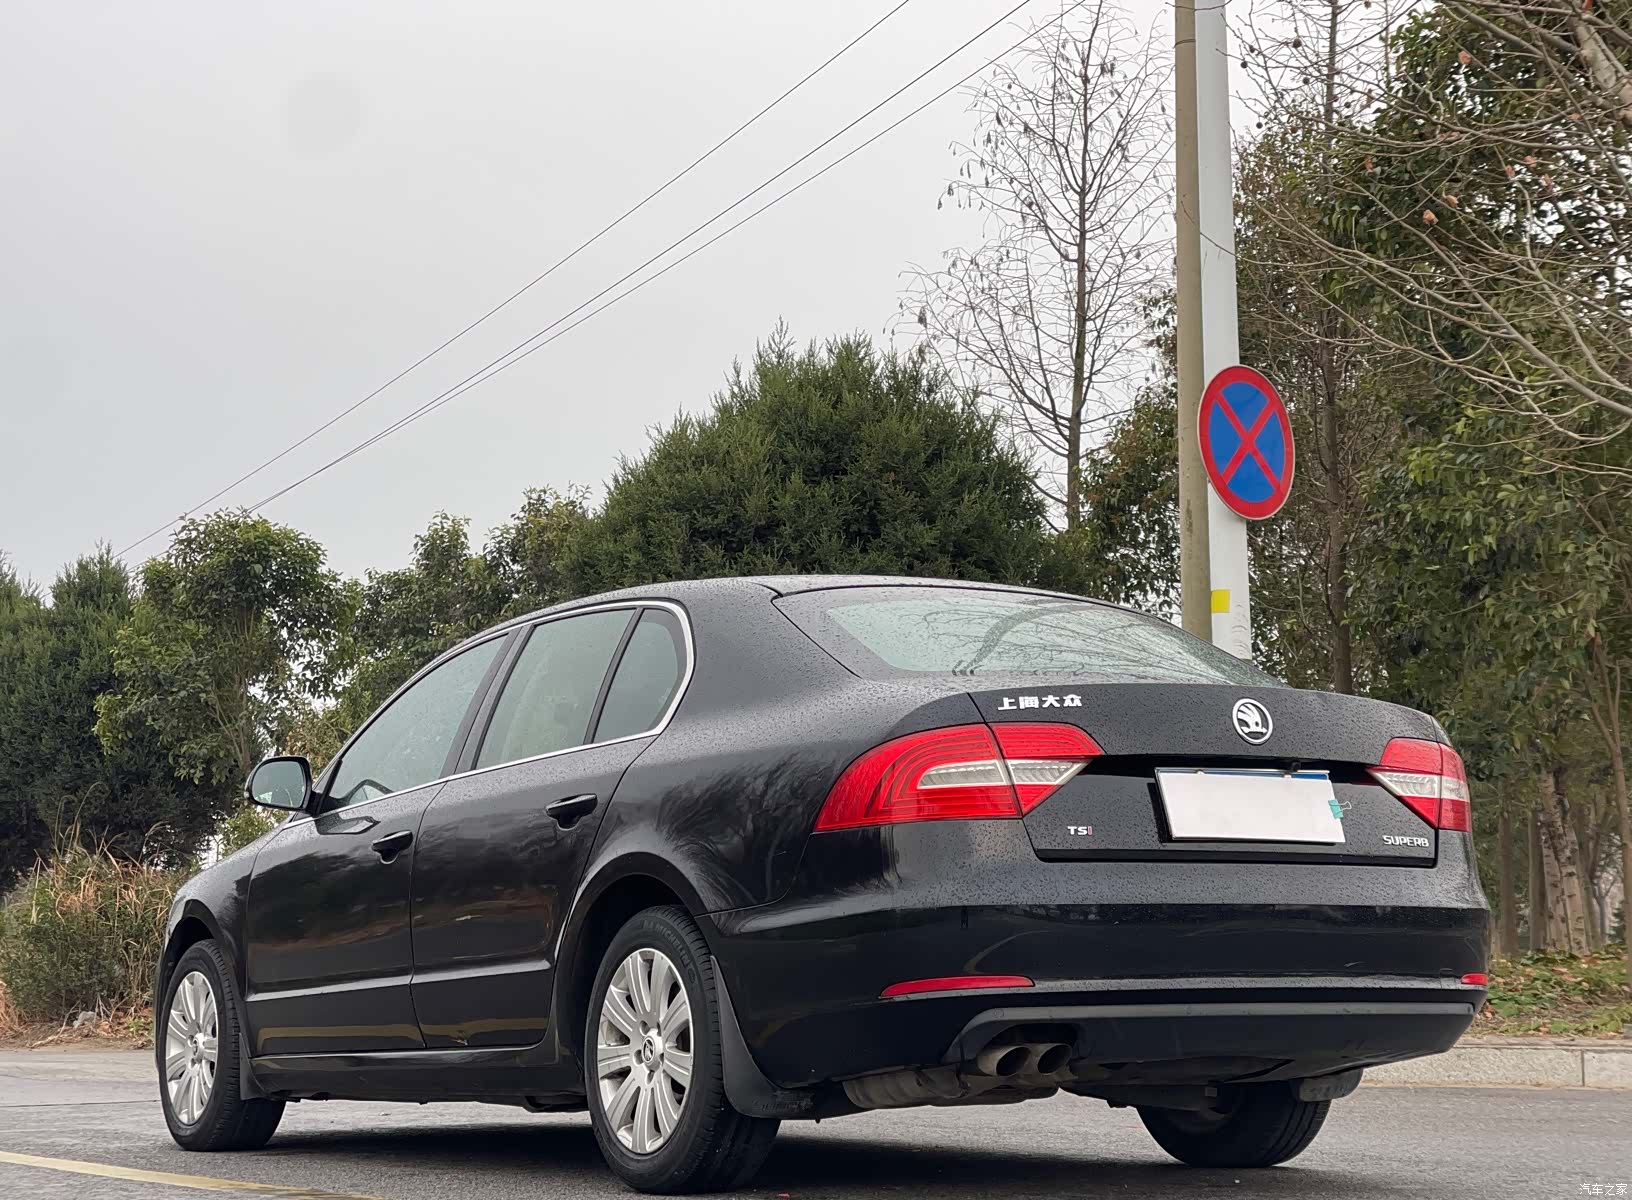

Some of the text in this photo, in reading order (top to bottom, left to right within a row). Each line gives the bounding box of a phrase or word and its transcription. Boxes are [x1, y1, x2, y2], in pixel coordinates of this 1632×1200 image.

[997, 694, 1082, 711] 上海大众
[1382, 834, 1429, 847] SUPERB
